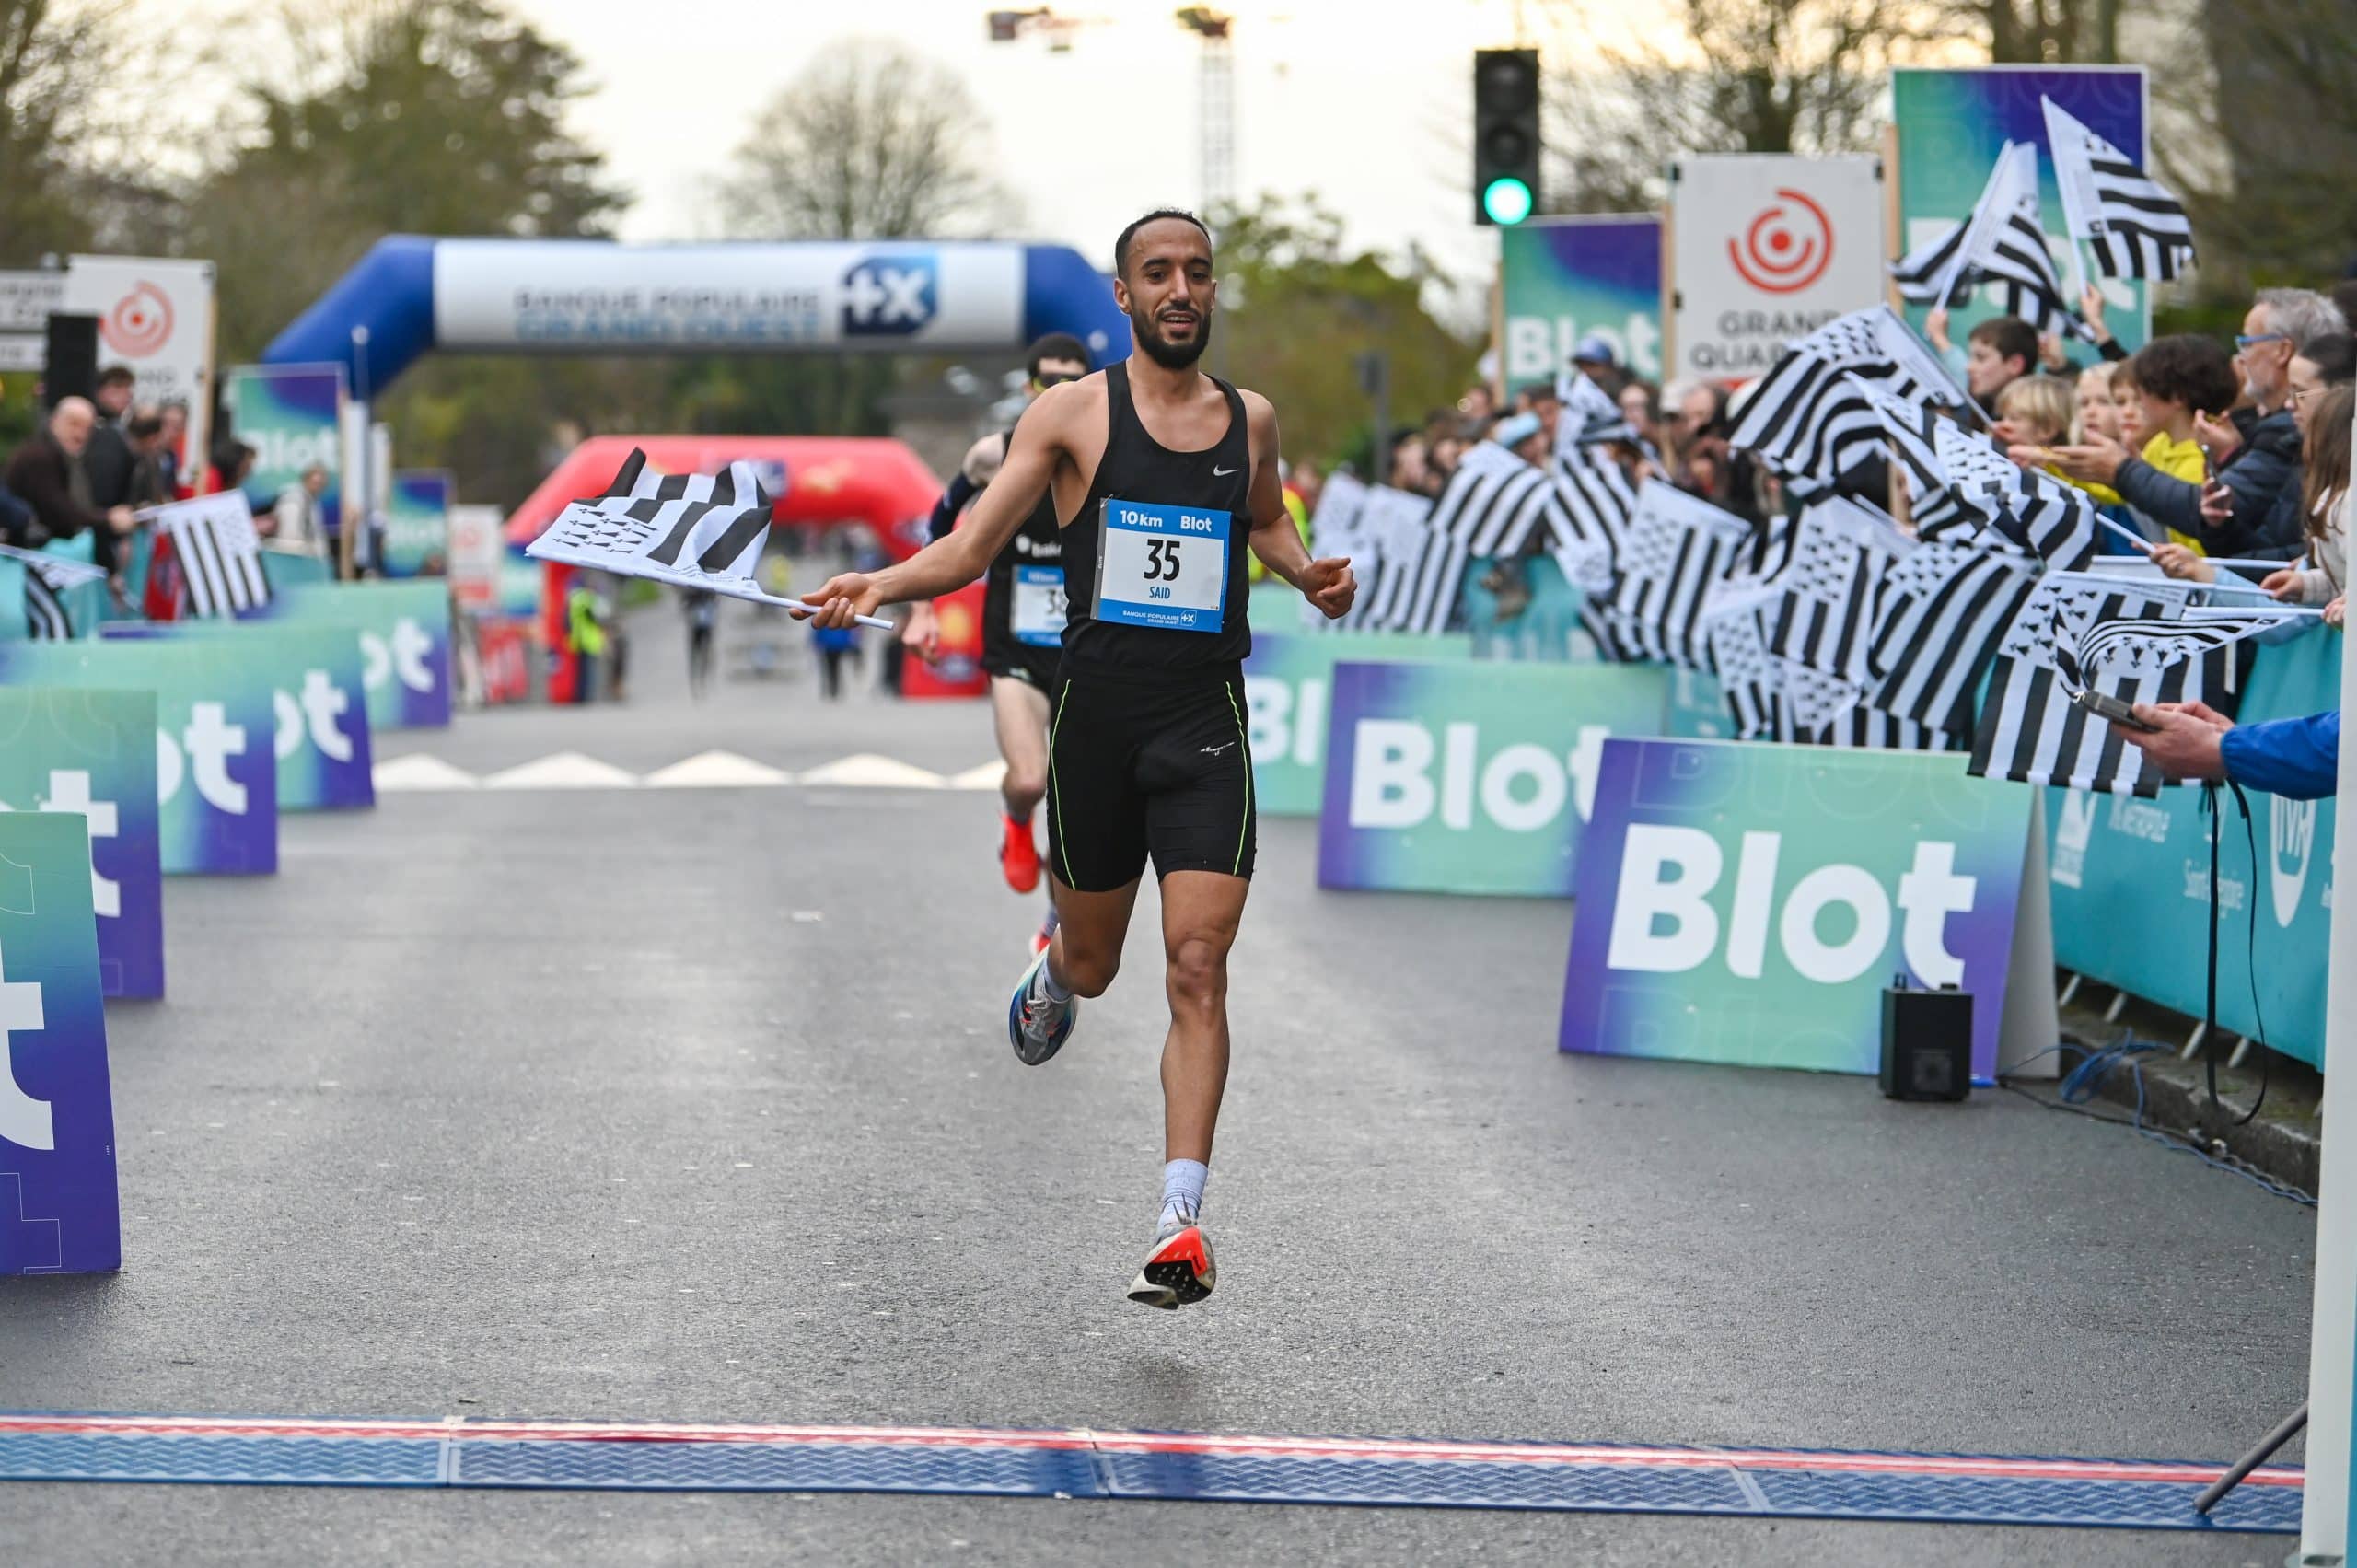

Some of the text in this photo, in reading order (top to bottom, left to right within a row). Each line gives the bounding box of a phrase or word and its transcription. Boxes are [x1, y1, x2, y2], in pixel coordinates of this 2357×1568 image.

[1120, 509, 1213, 532] 10km Blot
[1144, 538, 1181, 582] 35
[1149, 586, 1171, 599] SAID
[1122, 610, 1179, 621] BANQUE POPULAIRE
[1247, 677, 1325, 767] Bl
[1347, 716, 1611, 832] Blot
[1607, 822, 1979, 992] Blot
